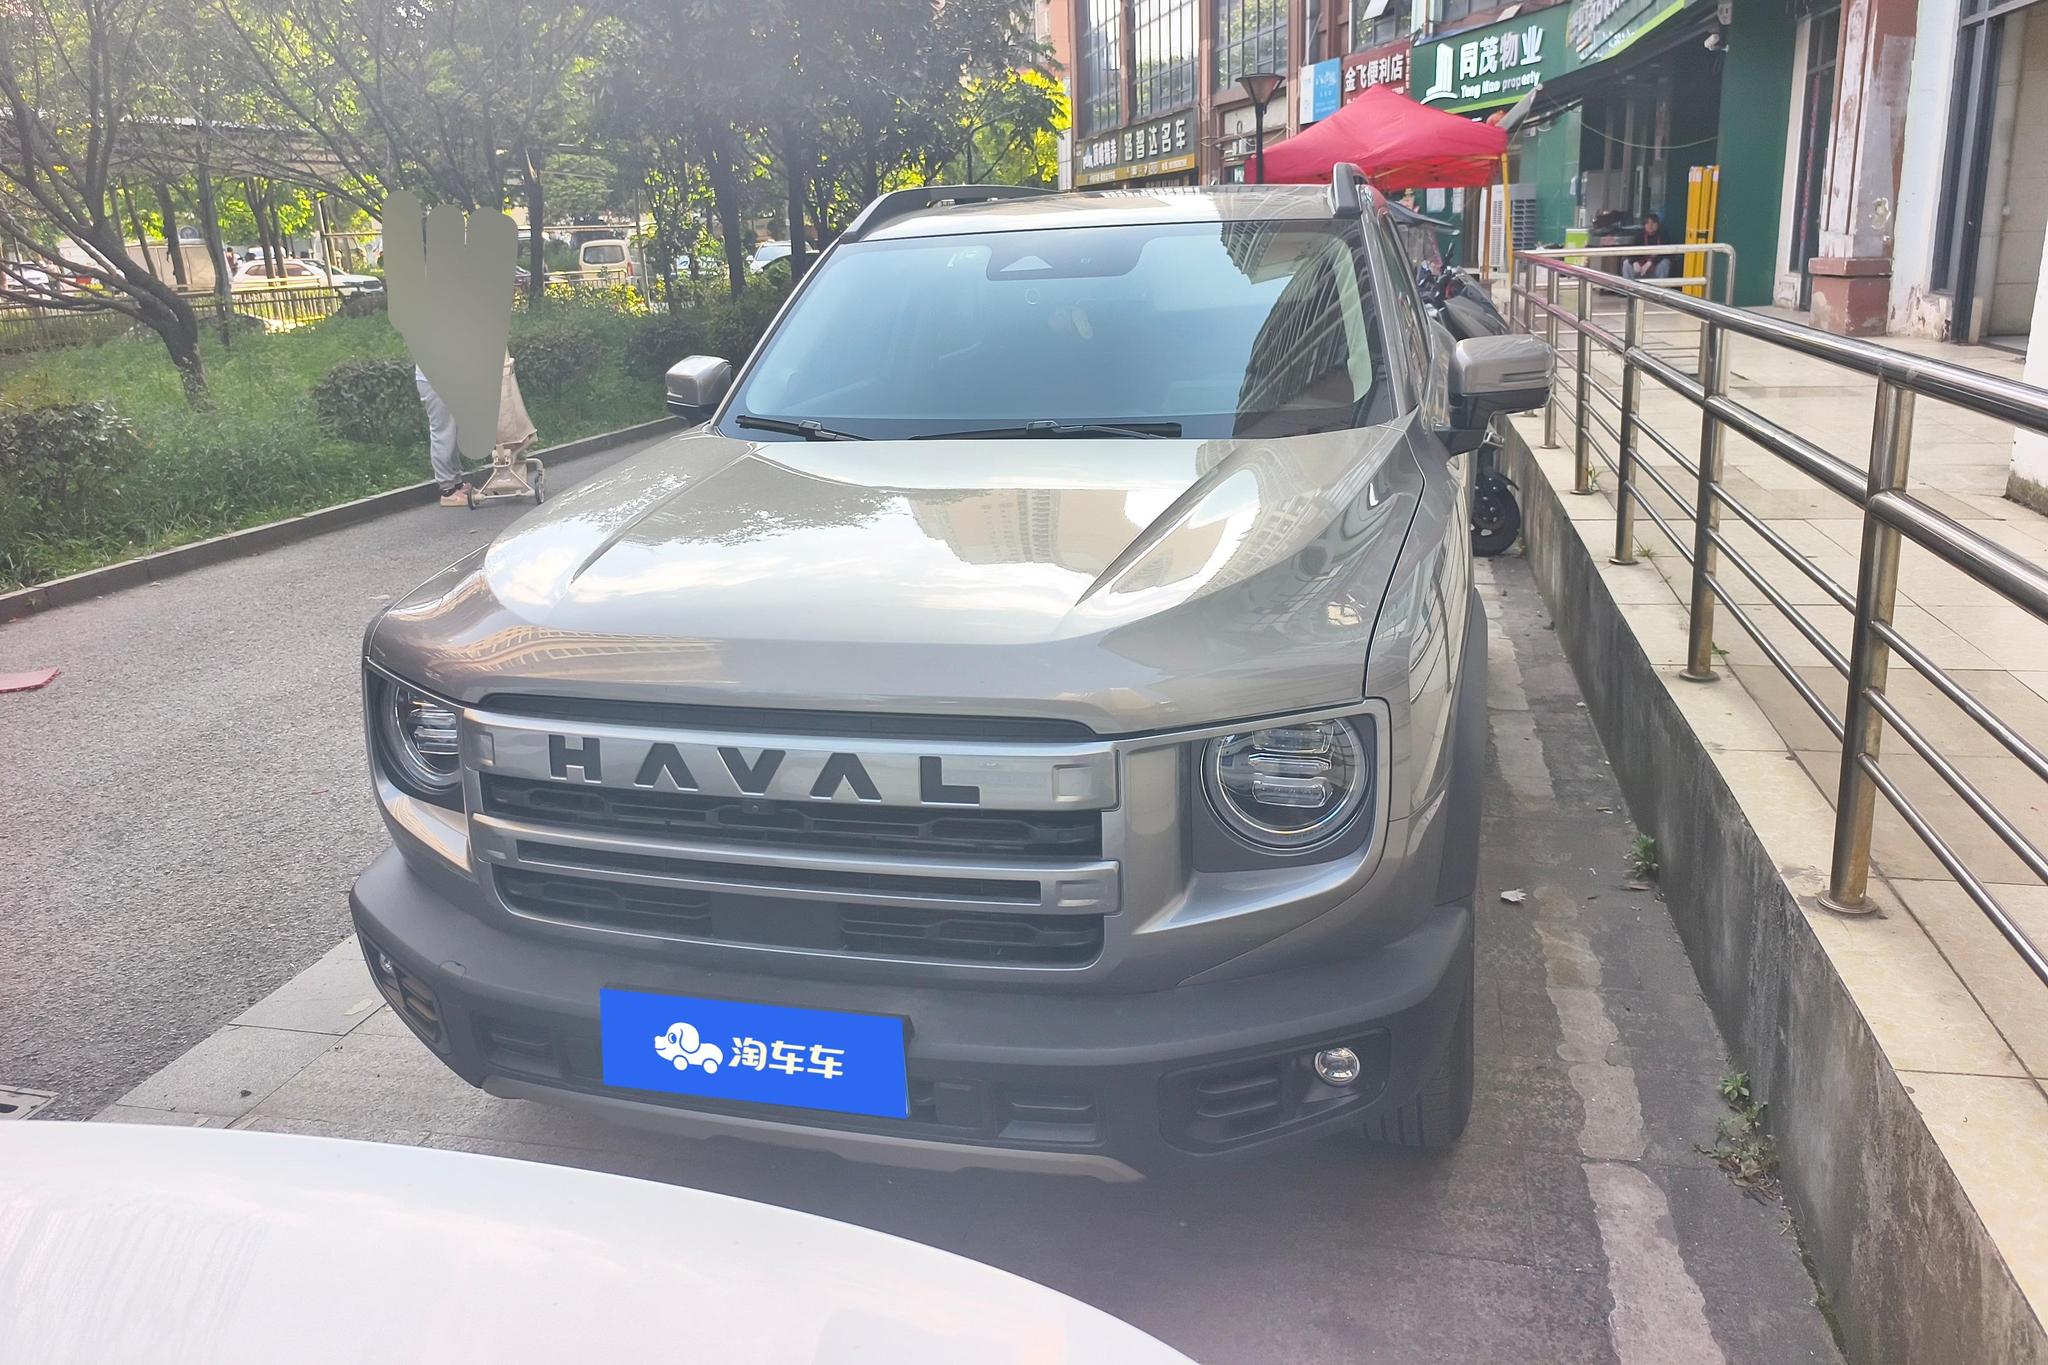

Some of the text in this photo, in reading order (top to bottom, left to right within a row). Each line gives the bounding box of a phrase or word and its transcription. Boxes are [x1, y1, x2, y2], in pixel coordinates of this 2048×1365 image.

[1345, 53, 1403, 92] 金飞便利店
[1460, 25, 1543, 80] 同茂物业
[548, 734, 980, 807] HAVAL
